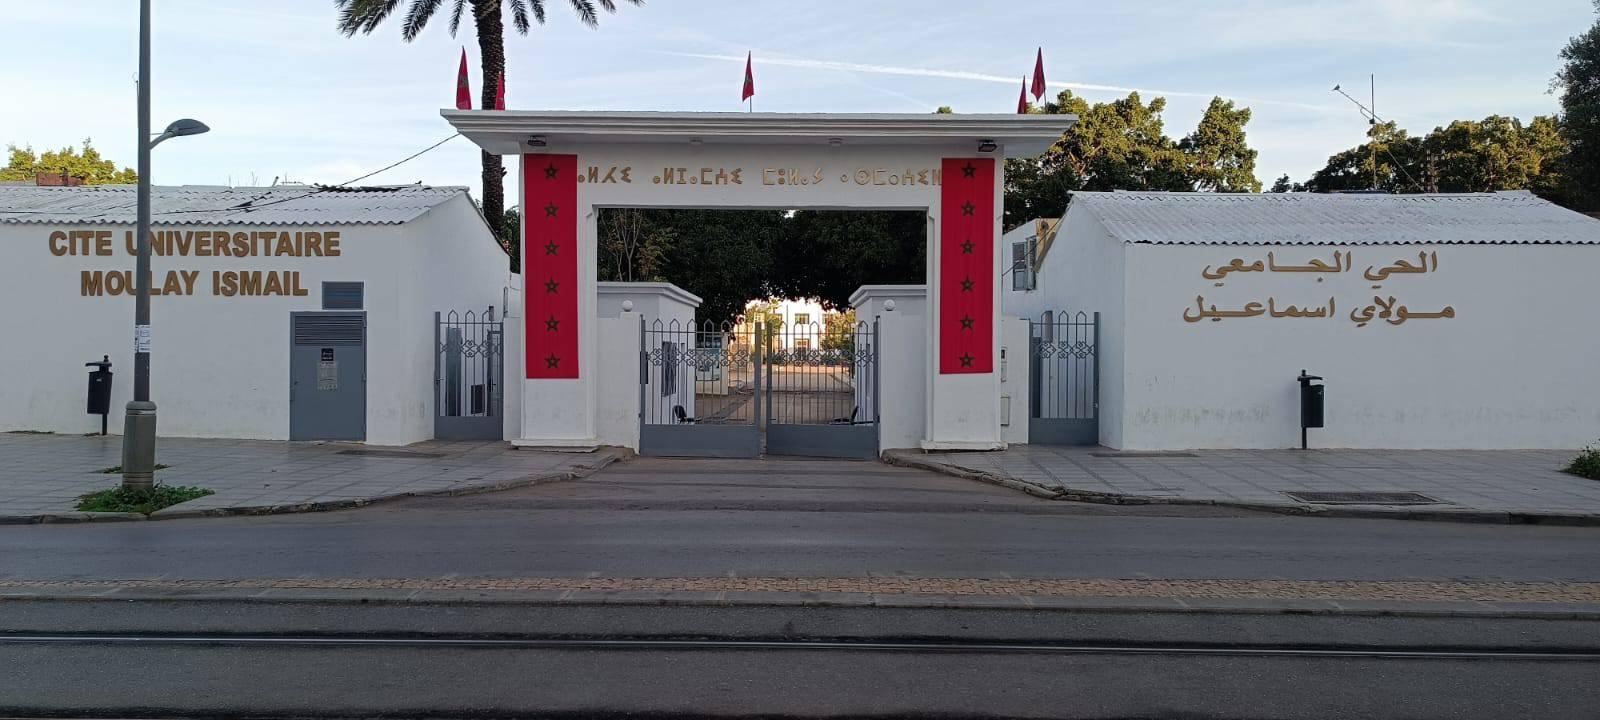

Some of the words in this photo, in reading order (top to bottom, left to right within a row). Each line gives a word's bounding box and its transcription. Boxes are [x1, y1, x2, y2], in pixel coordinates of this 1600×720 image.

[49, 231, 112, 256] CITE
[212, 270, 309, 297] ISMAIL
[1202, 250, 1352, 287] الجامعي
[1364, 250, 1438, 289] الحي
[1350, 296, 1456, 327] مولاي
